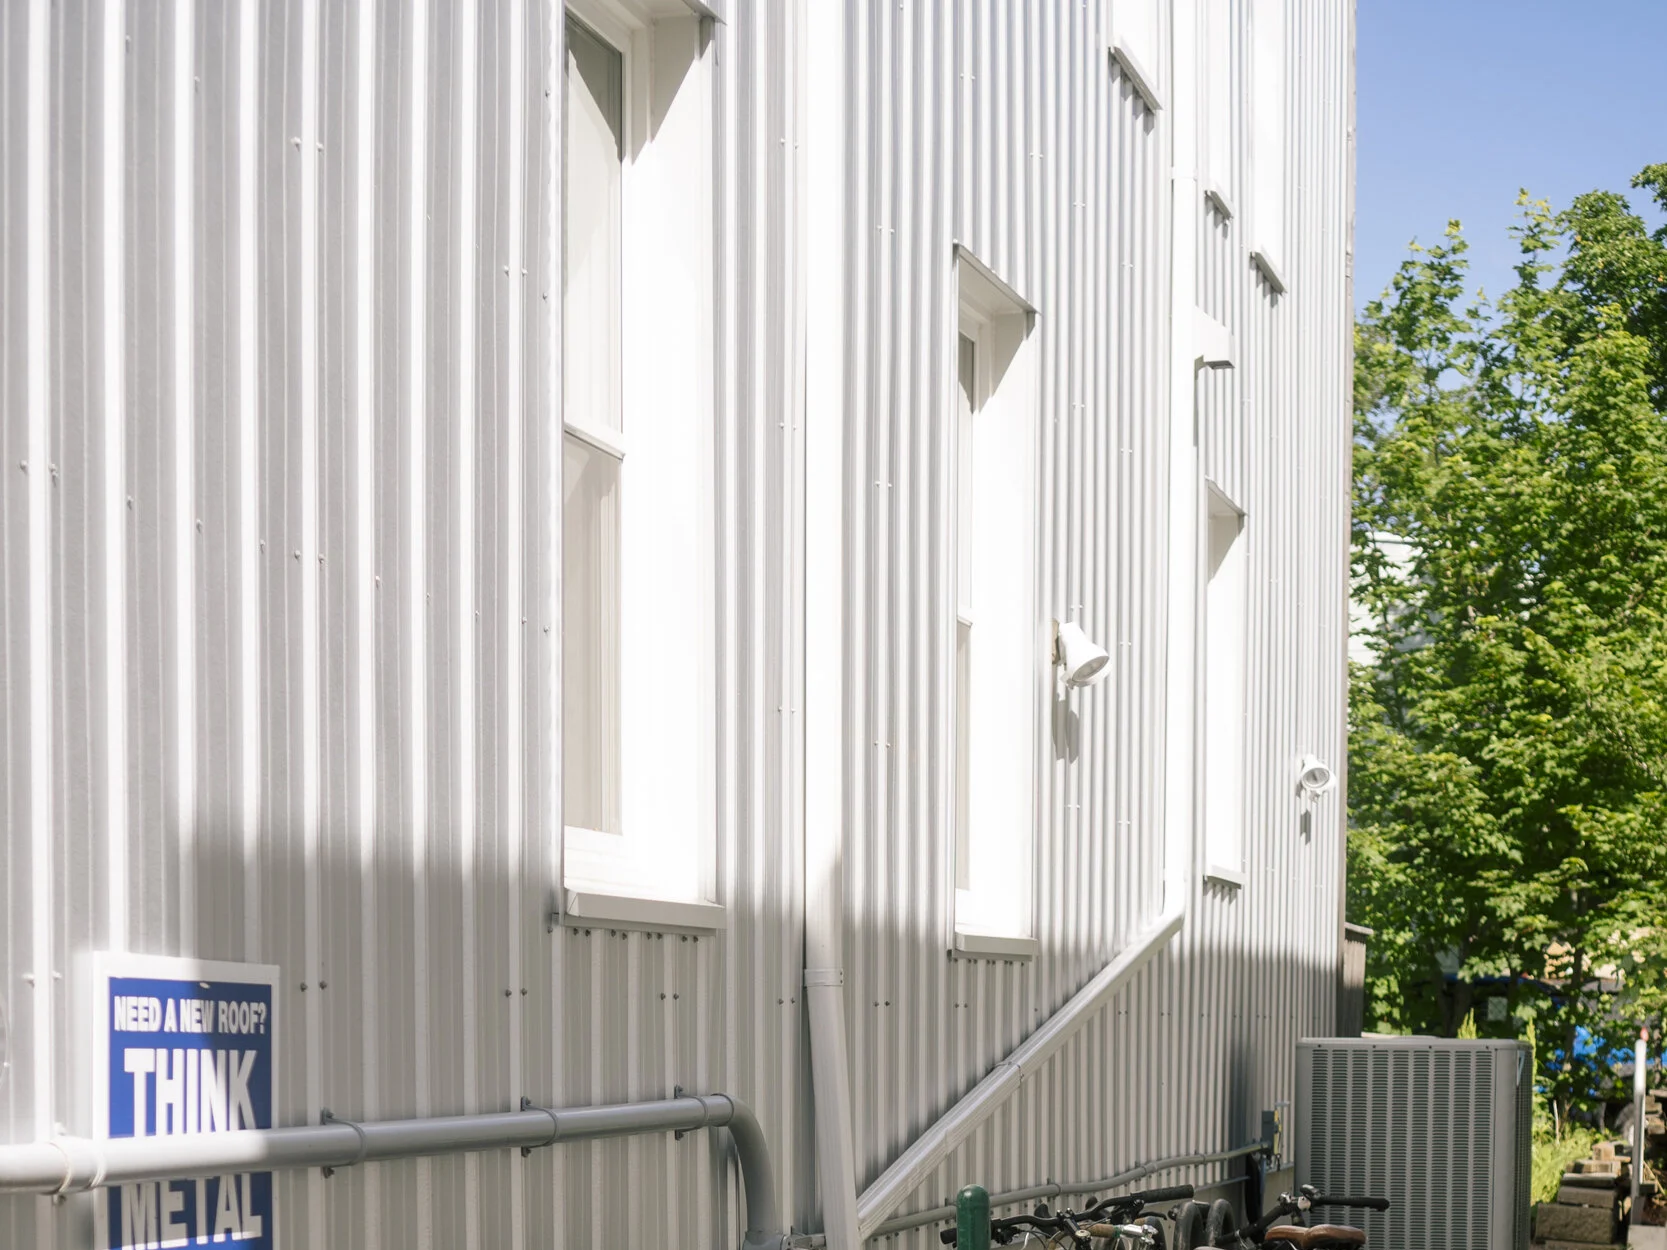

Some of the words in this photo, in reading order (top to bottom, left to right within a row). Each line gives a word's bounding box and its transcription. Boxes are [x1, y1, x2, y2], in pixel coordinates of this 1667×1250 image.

[114, 996, 162, 1032] NEED
[164, 998, 178, 1033] A
[179, 998, 214, 1034] NEW
[218, 1000, 267, 1035] ROOF?
[124, 1048, 257, 1137] THINK
